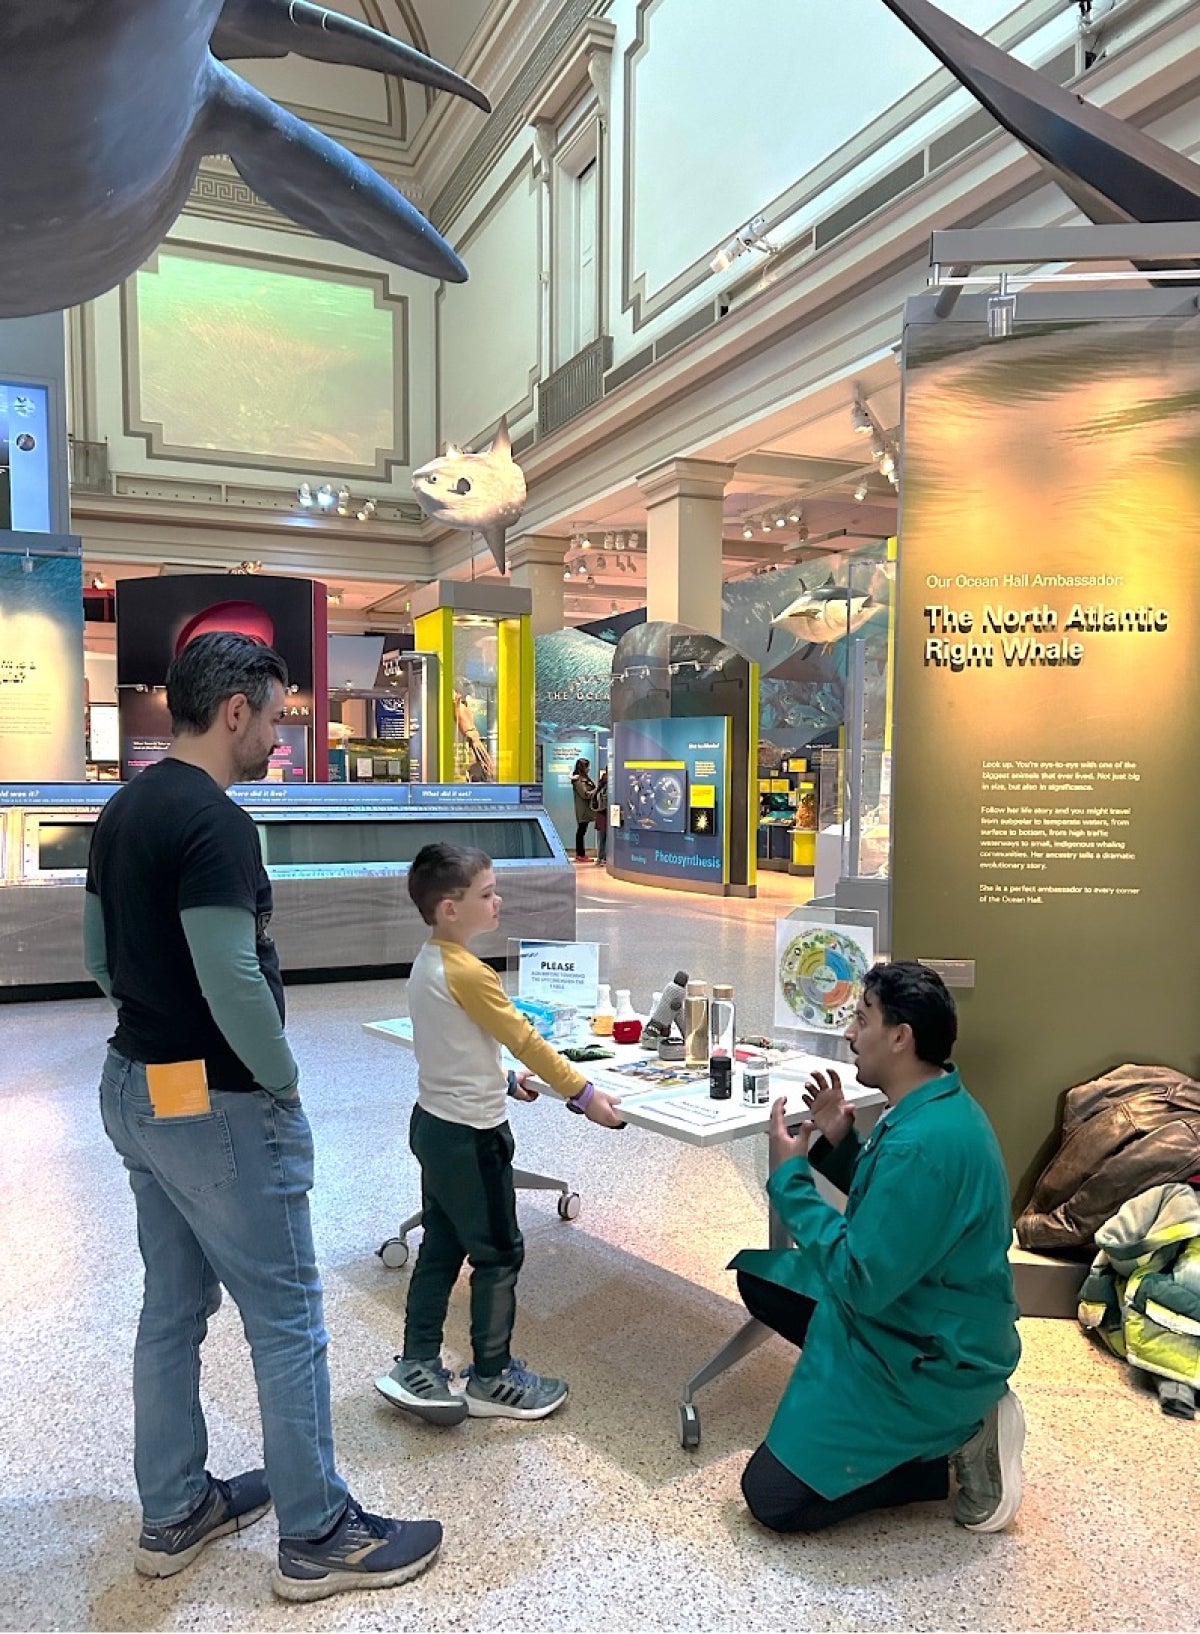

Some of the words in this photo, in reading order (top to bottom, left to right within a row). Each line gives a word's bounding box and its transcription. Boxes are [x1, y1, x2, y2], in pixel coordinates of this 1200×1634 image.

[926, 575, 952, 588] Our
[956, 575, 998, 588] Ocean
[1003, 575, 1028, 587] Hall
[1032, 574, 1124, 587] Ambassador:
[924, 605, 973, 633] The
[982, 604, 1058, 633] North
[1064, 603, 1168, 632] Atlantic
[924, 637, 994, 672] Right
[1001, 637, 1085, 666] Whale
[547, 692, 568, 701] THE
[577, 692, 611, 701] OCEA
[283, 706, 309, 716] EAN
[1002, 761, 1013, 769] up.
[982, 772, 1009, 780] biggest
[1041, 772, 1056, 780] that
[1075, 772, 1095, 780] lived.
[1112, 773, 1126, 781] just
[1128, 774, 1140, 782] big
[991, 783, 1007, 791] size,
[1048, 784, 1093, 792] significance.
[981, 806, 1005, 814] Follow
[1034, 808, 1052, 816] story
[1071, 808, 1085, 816] you
[1086, 808, 1108, 816] might
[1043, 818, 1081, 827] temperate
[1082, 819, 1109, 827] waters,
[1018, 829, 1047, 837] bottom,
[1049, 829, 1067, 837] from
[1069, 830, 1085, 838] high
[1087, 830, 1108, 838] traffic
[980, 840, 1020, 848] waterways
[1021, 840, 1029, 848] to
[1054, 841, 1095, 849] indigenous
[1097, 841, 1125, 849] whaling
[655, 849, 721, 869] Photosynthesis
[1046, 852, 1077, 860] ancestry
[1103, 852, 1136, 860] dramatic
[980, 862, 1025, 870] evolutionary
[1010, 885, 1037, 894] perfect
[1094, 887, 1115, 895] every
[540, 961, 575, 971] PLEASE
